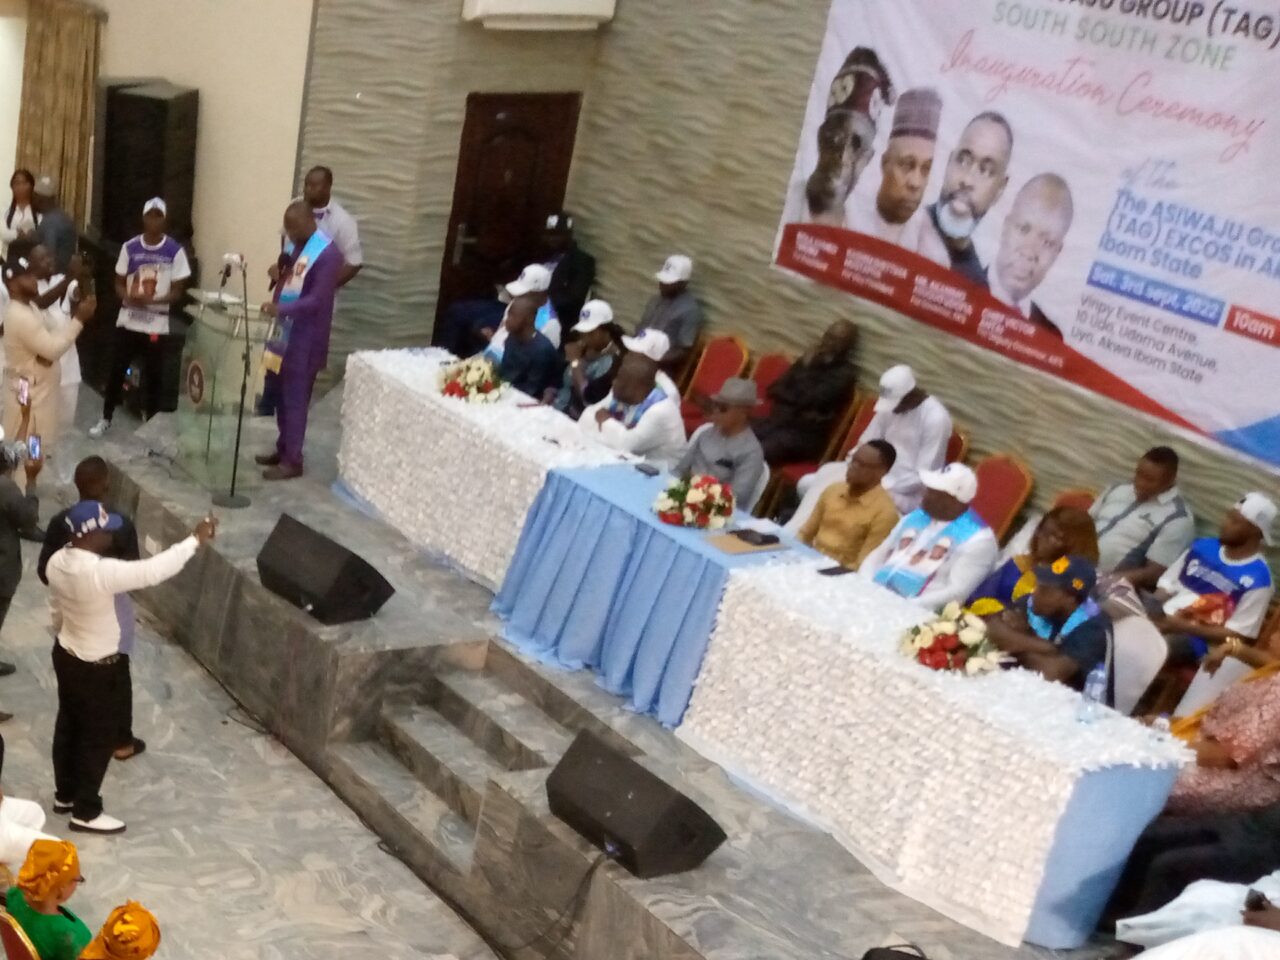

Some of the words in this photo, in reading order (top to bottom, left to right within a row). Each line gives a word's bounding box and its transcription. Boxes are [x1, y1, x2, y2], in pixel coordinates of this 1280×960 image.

[992, 3, 1069, 36] SOUTH
[1074, 16, 1158, 54] SOUTH
[1163, 34, 1238, 71] ZONE
[1119, 0, 1204, 26] GROUP
[1115, 69, 1266, 164] Ceremony
[1106, 204, 1162, 247] (TAG)
[1164, 228, 1232, 264] EXCOS
[1234, 246, 1257, 270] in
[1117, 188, 1147, 216] The
[1150, 201, 1244, 242] ASIWAJU
[1099, 231, 1146, 262] Ibom
[1149, 248, 1202, 279] State
[1116, 306, 1151, 329] Event
[1182, 294, 1220, 320] 2022
[1233, 311, 1275, 340] 10am
[1098, 336, 1132, 358] Akwa
[1133, 347, 1167, 371] Ibom
[1169, 361, 1203, 384] State
